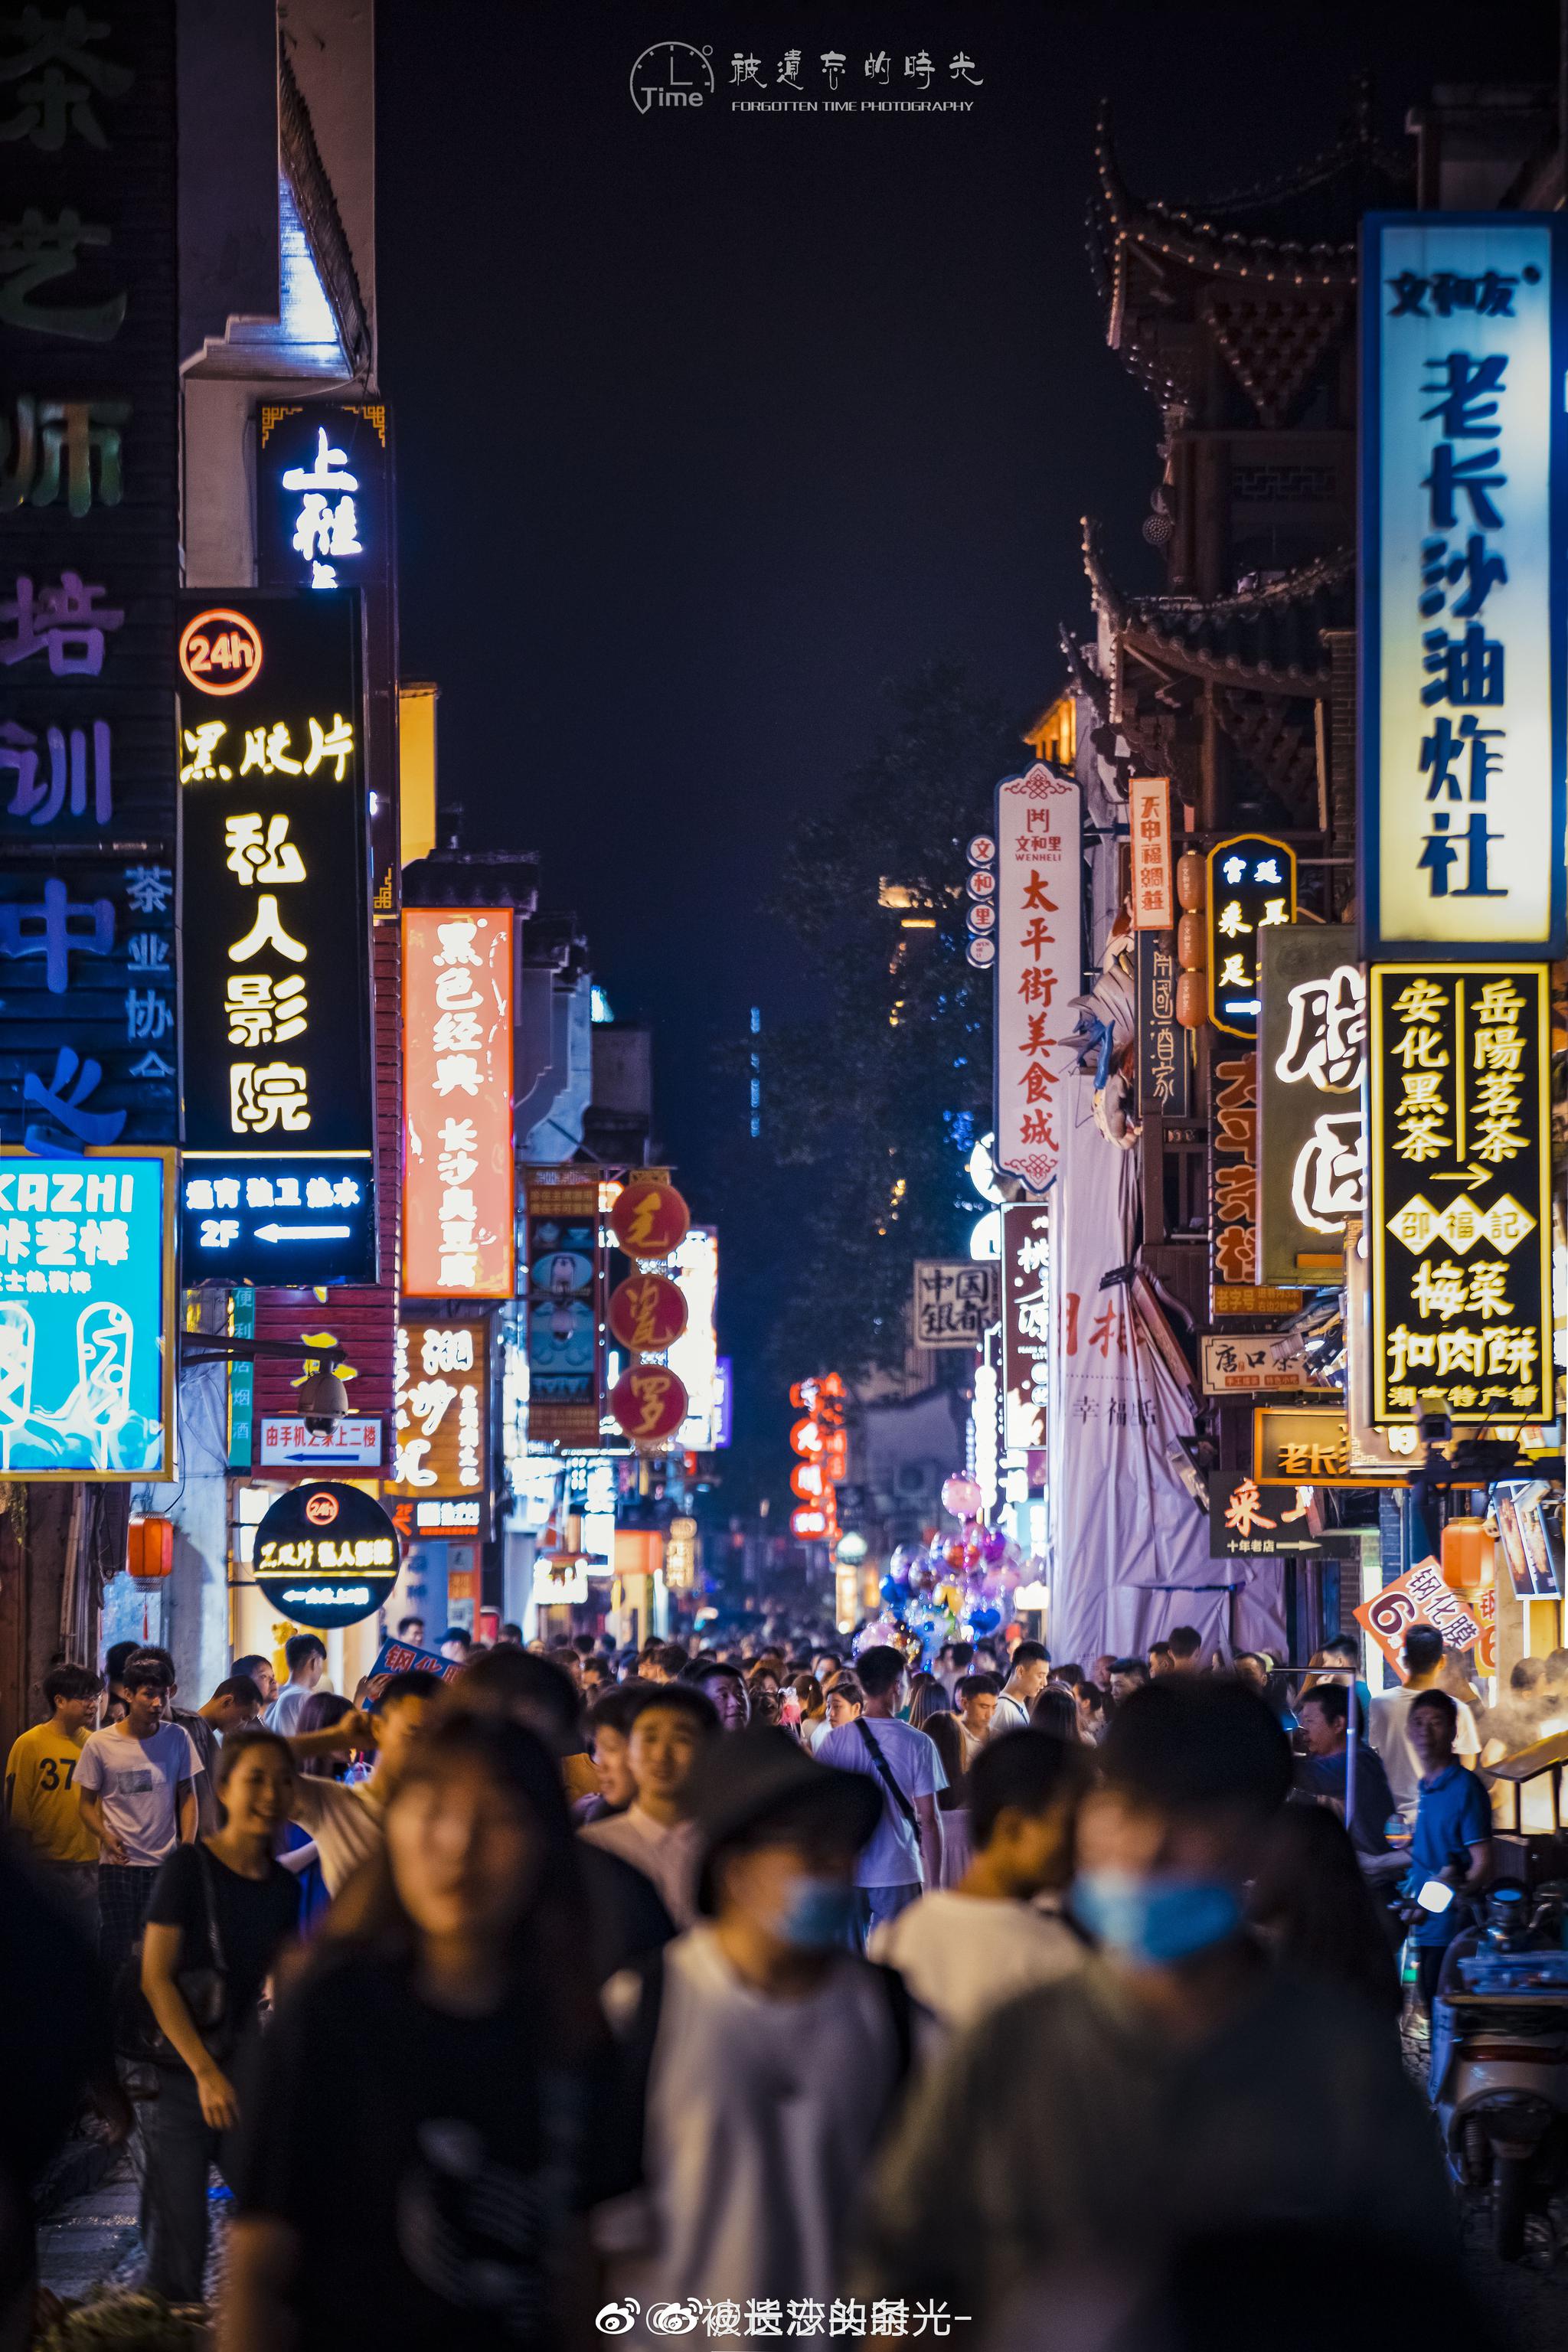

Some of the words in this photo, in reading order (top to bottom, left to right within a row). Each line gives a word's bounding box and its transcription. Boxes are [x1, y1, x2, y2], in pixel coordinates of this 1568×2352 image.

[1385, 270, 1521, 318] 文和友
[188, 635, 255, 672] 24h
[1416, 351, 1510, 898] 老长沙油炸社
[1015, 835, 1062, 851] 文和里
[224, 813, 311, 1134] 私人影院
[1218, 953, 1262, 988] 足
[432, 921, 485, 1097] 黑色经典
[1018, 869, 1060, 1152] 太平街美食城
[1391, 977, 1454, 1162] 安化黑茶
[1470, 977, 1530, 1163] 岳陽茗茶
[437, 1118, 479, 1288] 长沙臭豆腐
[1401, 1210, 1521, 1240] 邵福記
[1411, 1259, 1515, 1322] 梅菜
[1387, 1325, 1540, 1385] 扣肉餅
[1227, 1539, 1275, 1553] 十年老店
[1370, 1592, 1416, 1635] 6
[1406, 1566, 1479, 1649] 钢化膜
[39, 1757, 77, 1792] 37
